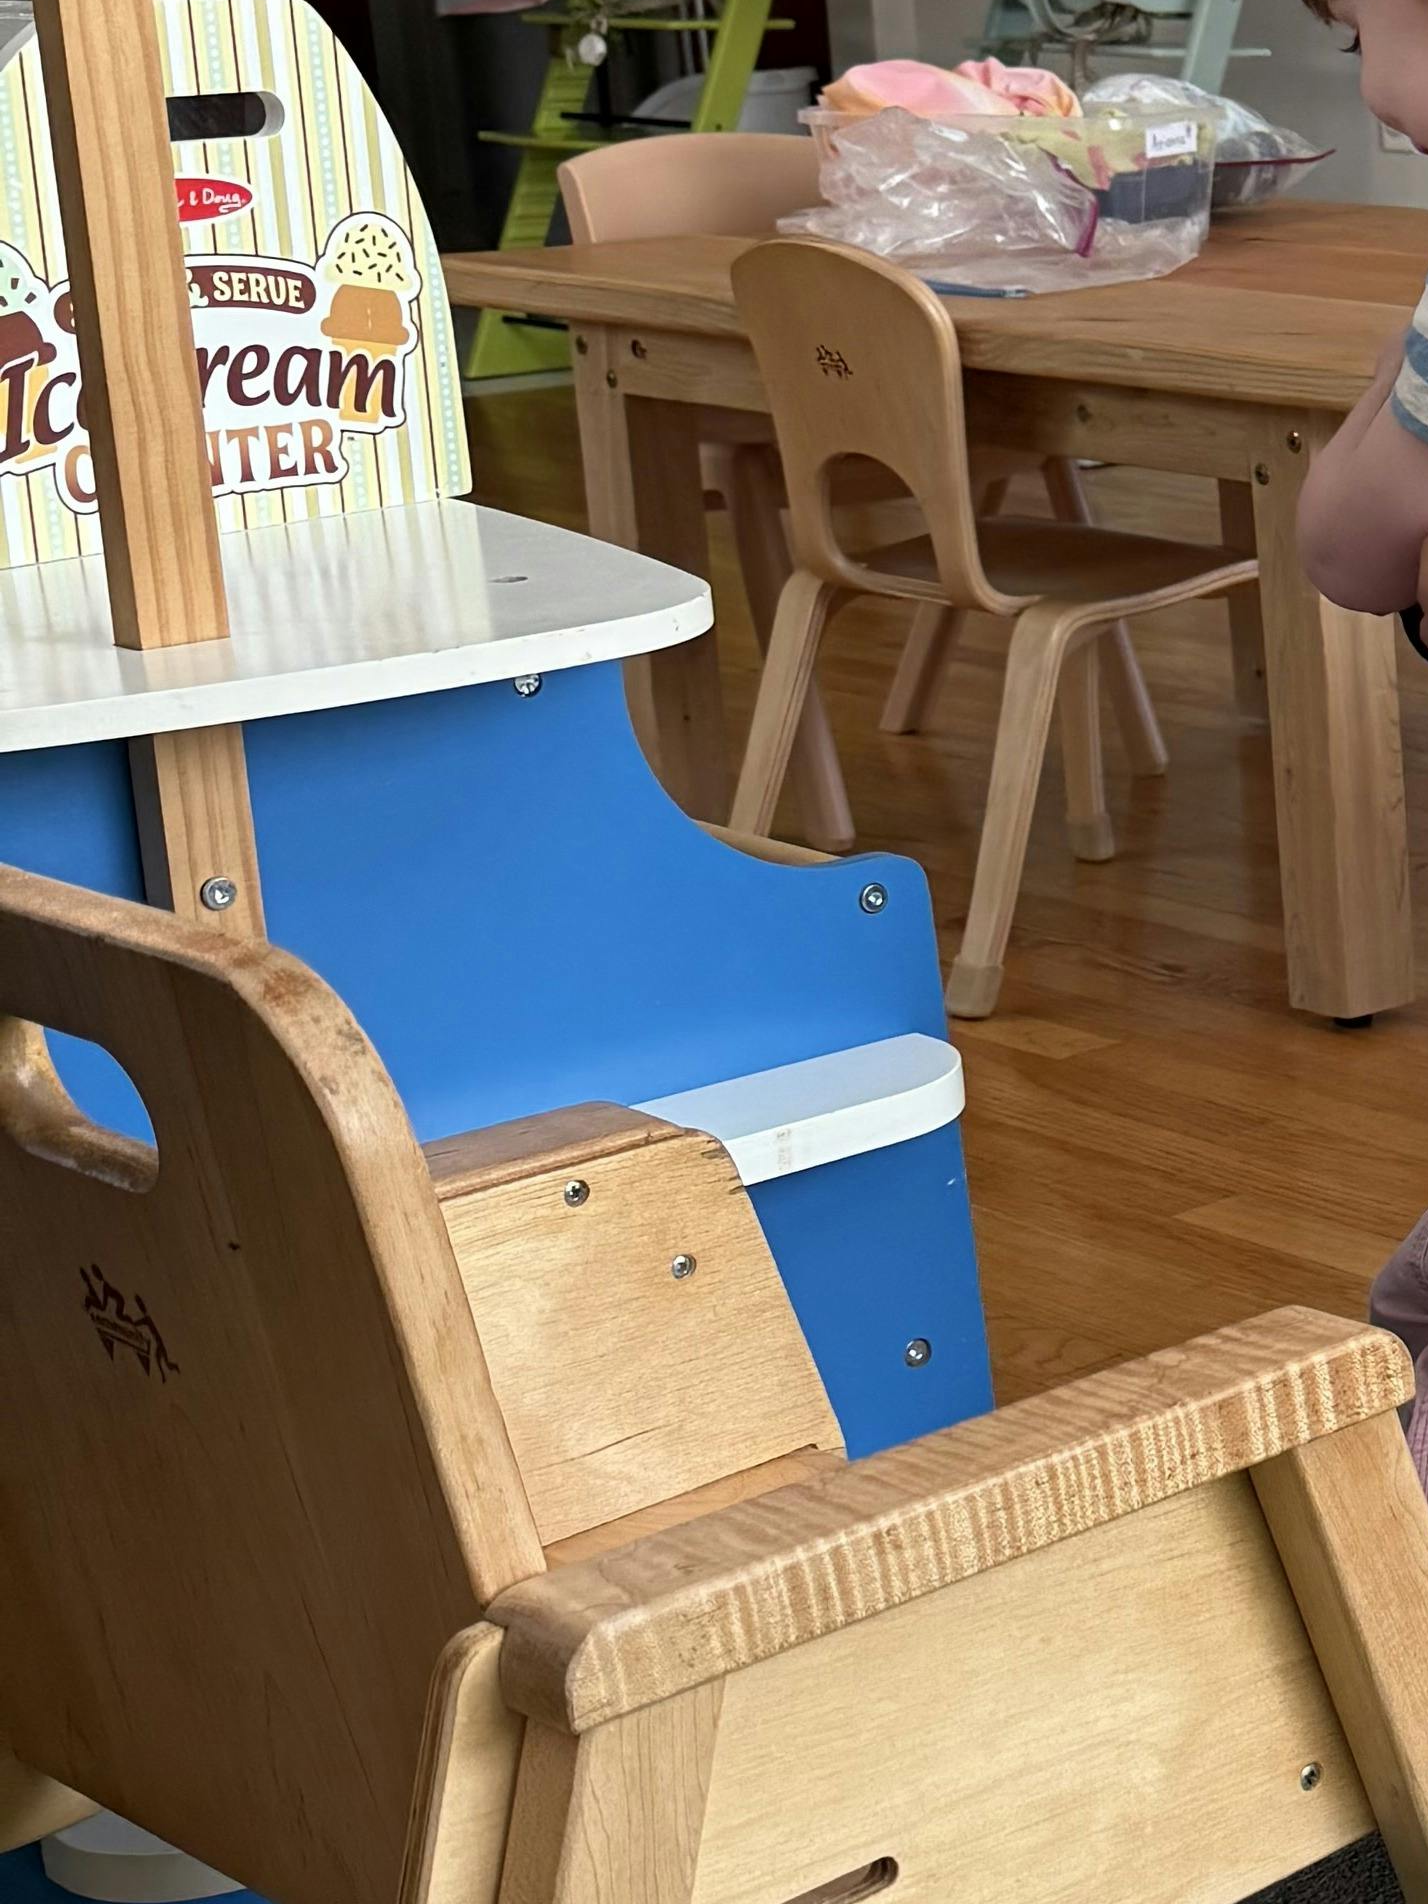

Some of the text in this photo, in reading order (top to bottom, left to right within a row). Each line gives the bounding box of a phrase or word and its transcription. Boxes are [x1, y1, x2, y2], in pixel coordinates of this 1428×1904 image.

[202, 187, 242, 213] Doug
[212, 271, 305, 309] SERVE
[0, 344, 396, 462] Ic ream
